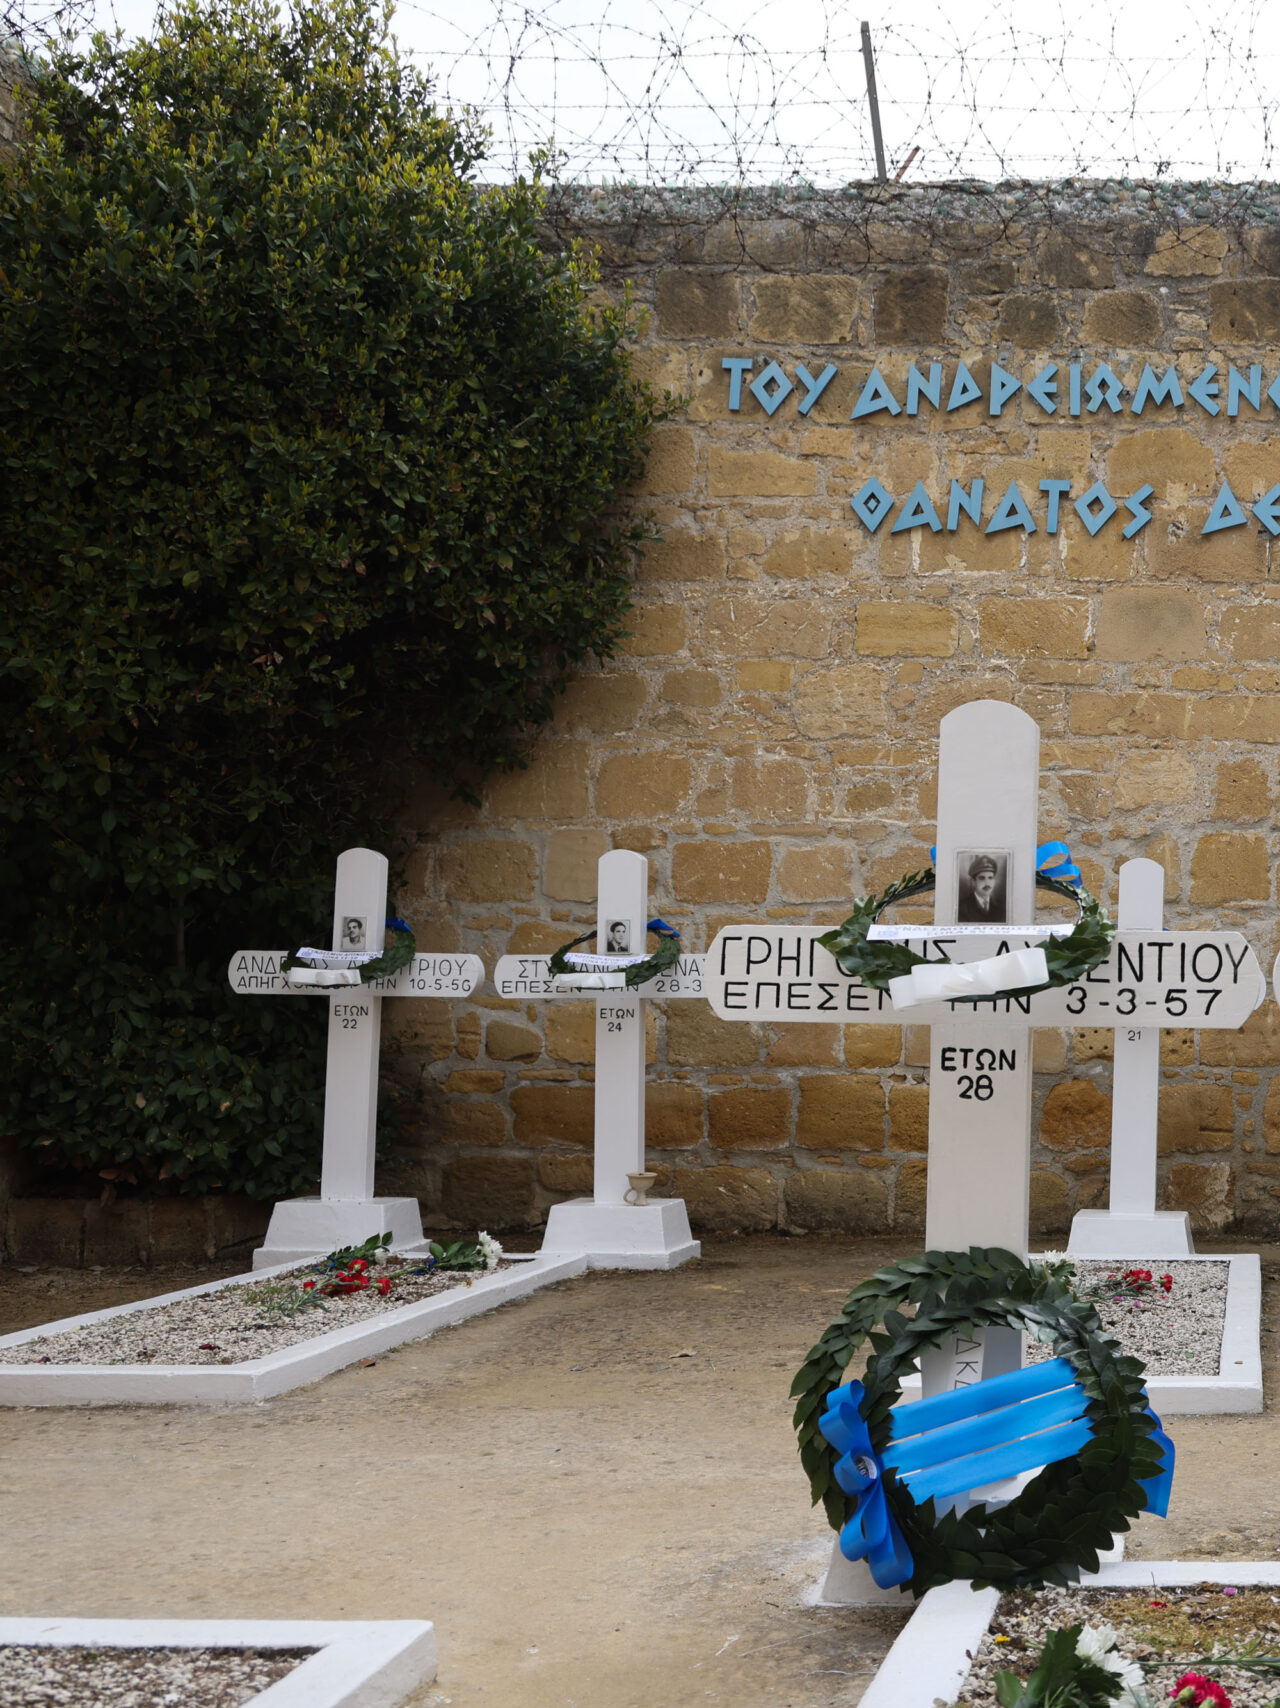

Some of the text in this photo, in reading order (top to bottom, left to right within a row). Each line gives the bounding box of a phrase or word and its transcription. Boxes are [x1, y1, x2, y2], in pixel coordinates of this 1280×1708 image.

[722, 357, 838, 416] ΤΟΥ
[850, 476, 1154, 539] ΘΑΝΑΤΟΣ
[715, 936, 956, 978] ΓΡΗΓ
[996, 940, 1249, 984] ΕΝΤΙΟΥ
[333, 1004, 369, 1017] ΕΤΩΝ
[599, 1007, 635, 1019] ΕΤΩΝ
[1066, 986, 1223, 1017] 3-3-57
[342, 1018, 358, 1030] 22
[607, 1021, 622, 1032] 24
[1127, 1029, 1142, 1042] 21
[941, 1046, 1016, 1072] ΕΤΩΝ
[957, 1073, 994, 1102] 28
